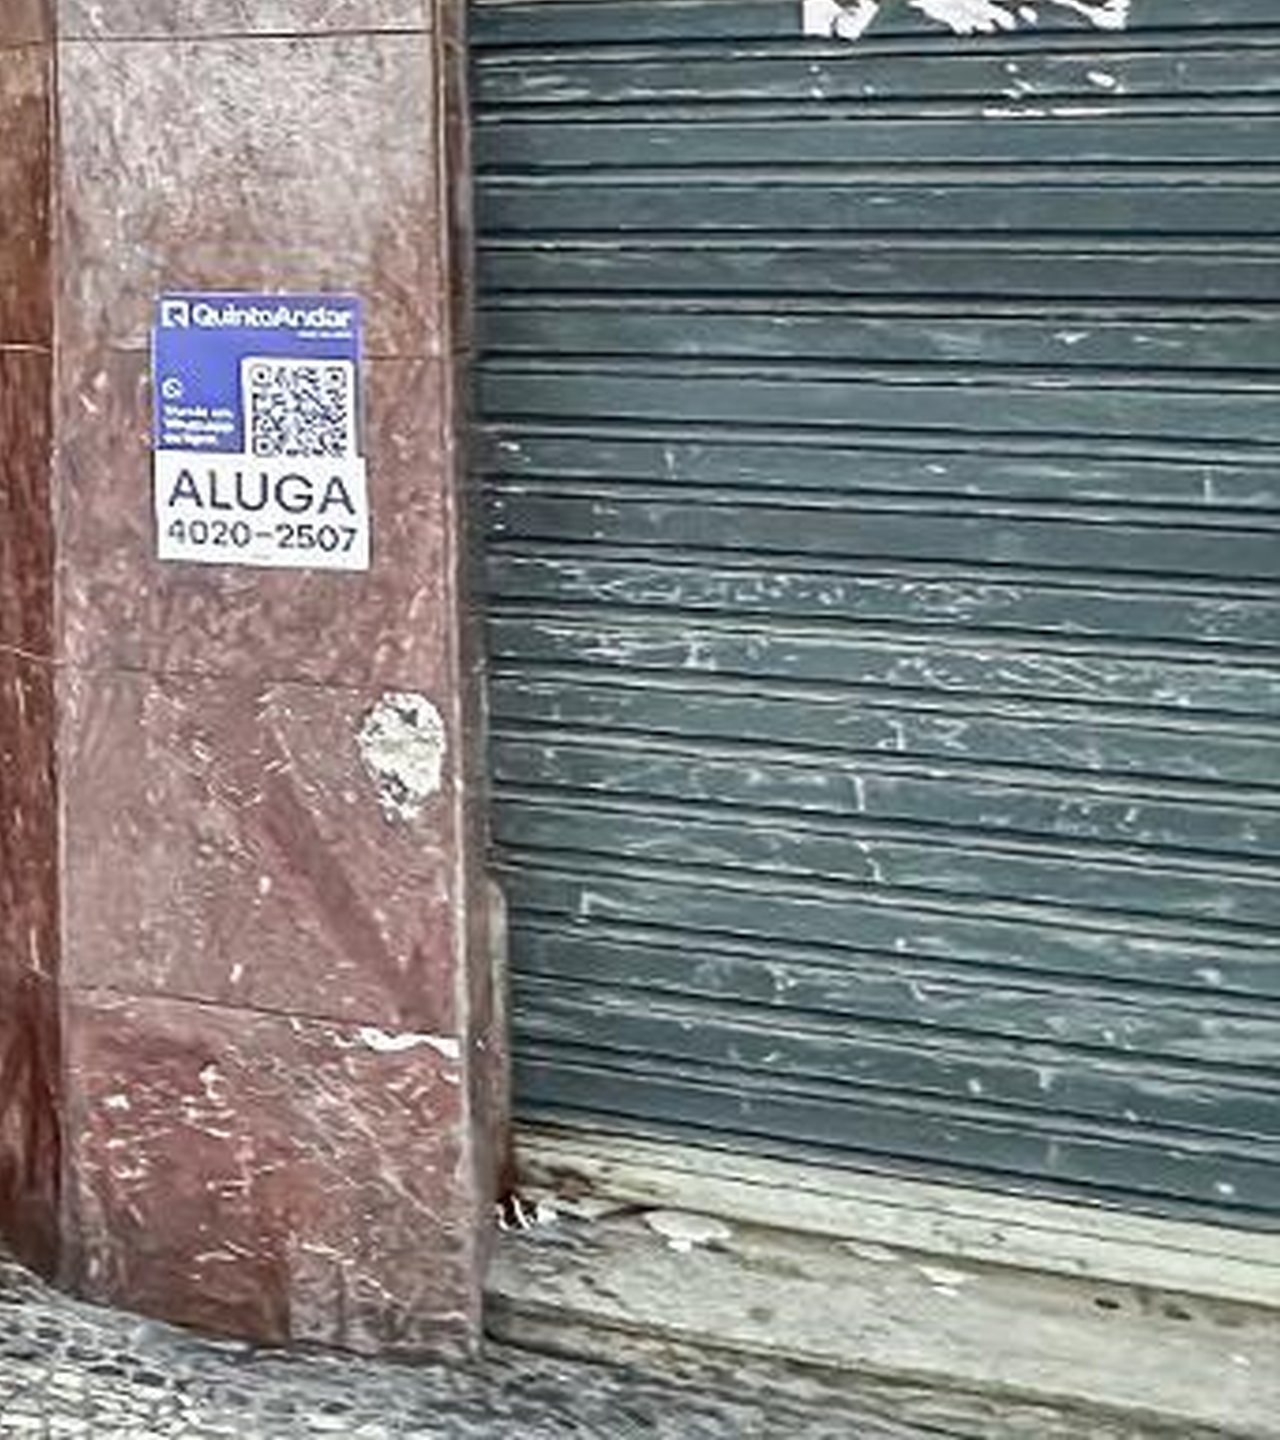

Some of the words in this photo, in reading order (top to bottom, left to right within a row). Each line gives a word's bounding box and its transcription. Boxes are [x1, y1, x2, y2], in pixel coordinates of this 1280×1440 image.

[191, 303, 353, 329] QuintoAndar
[167, 468, 358, 516] ALUGA
[168, 518, 359, 553] 4020-2507
